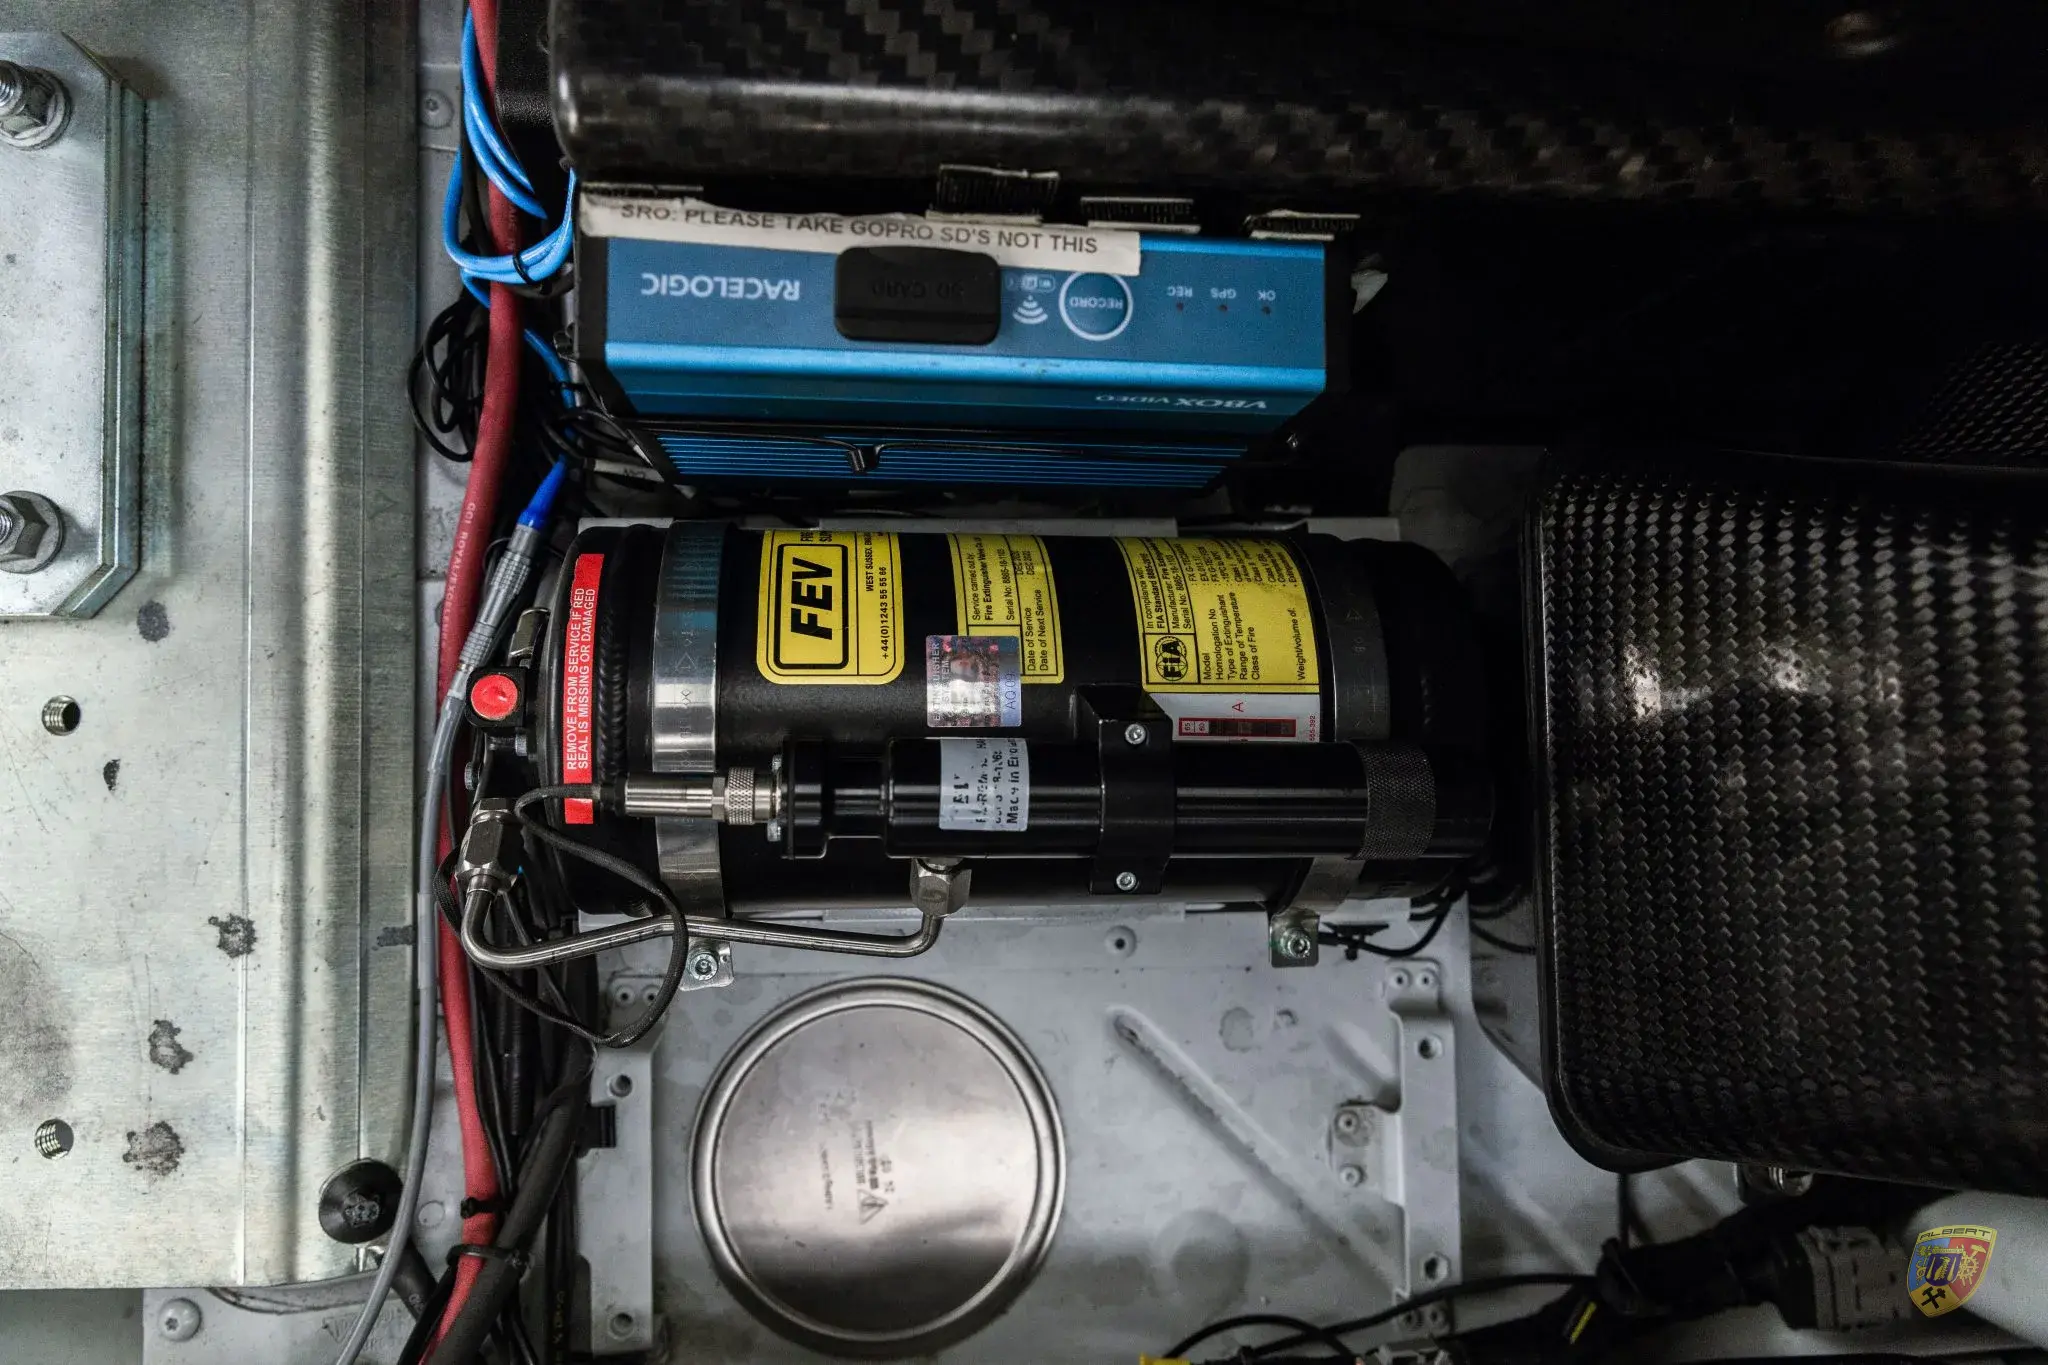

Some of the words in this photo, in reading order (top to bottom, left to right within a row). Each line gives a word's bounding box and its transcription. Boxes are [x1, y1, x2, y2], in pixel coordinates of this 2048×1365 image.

[685, 208, 776, 229] PLEASE
[784, 215, 844, 234] TAKE
[851, 218, 934, 240] GOPRO
[940, 227, 991, 245] SD'S
[999, 230, 1043, 250] NOT
[1052, 234, 1098, 254] THIS
[640, 272, 801, 300] RACELOGIC
[1166, 286, 1193, 298] REC
[1209, 287, 1237, 300] GPS
[1257, 290, 1277, 301] OK
[1070, 296, 1123, 310] RECORD
[1095, 394, 1170, 405] VIDEO
[1173, 397, 1268, 409] VBOX
[967, 560, 976, 569] out
[1161, 568, 1173, 580] Fire
[866, 571, 874, 592] WEST
[879, 577, 887, 587] 55
[969, 570, 978, 591] carried
[980, 561, 992, 603] Extinguisher
[572, 587, 585, 608] RED
[790, 556, 833, 640] FEV
[879, 589, 887, 599] 55
[1001, 586, 1013, 597] No:
[1034, 589, 1044, 615] Service
[1139, 580, 1152, 620] compliance
[1150, 580, 1163, 613] Standard
[1179, 593, 1189, 606] No:
[580, 588, 596, 642] DAMAGED
[972, 593, 981, 621] Service
[984, 605, 993, 621] Fire
[1004, 599, 1015, 621] Serial
[1166, 581, 1181, 629] Manufacturer:
[1208, 608, 1218, 619] No
[1228, 592, 1243, 637] Temperature
[1288, 607, 1299, 620] of:
[571, 611, 582, 621] IF
[1024, 607, 1033, 637] Service
[1144, 621, 1154, 629] In
[1156, 615, 1165, 629] FIA
[1181, 607, 1193, 629] Serial
[1217, 594, 1233, 645] Extinguishant
[1036, 618, 1045, 637] Next
[1246, 627, 1256, 642] Fire
[567, 623, 581, 673] SERVICE
[579, 644, 591, 663] OR
[1026, 639, 1035, 648] of
[1038, 639, 1047, 647] of
[1211, 621, 1224, 680] Homologation
[1225, 648, 1234, 656] of
[1236, 639, 1246, 649] of
[1248, 644, 1257, 653] of
[1292, 621, 1306, 680] Weight/volume
[1026, 651, 1035, 671] Date
[1039, 650, 1048, 671] Date
[1161, 640, 1181, 678] FIA
[1203, 653, 1212, 680] Model
[1227, 658, 1239, 680] Type
[1239, 651, 1249, 680] Range
[1251, 654, 1260, 680] Class
[567, 676, 579, 713] FROM
[579, 665, 590, 718] MISSING
[1232, 701, 1244, 713] A
[579, 720, 589, 733] IS
[566, 716, 578, 770] REMOVE
[578, 736, 589, 769] SEAL
